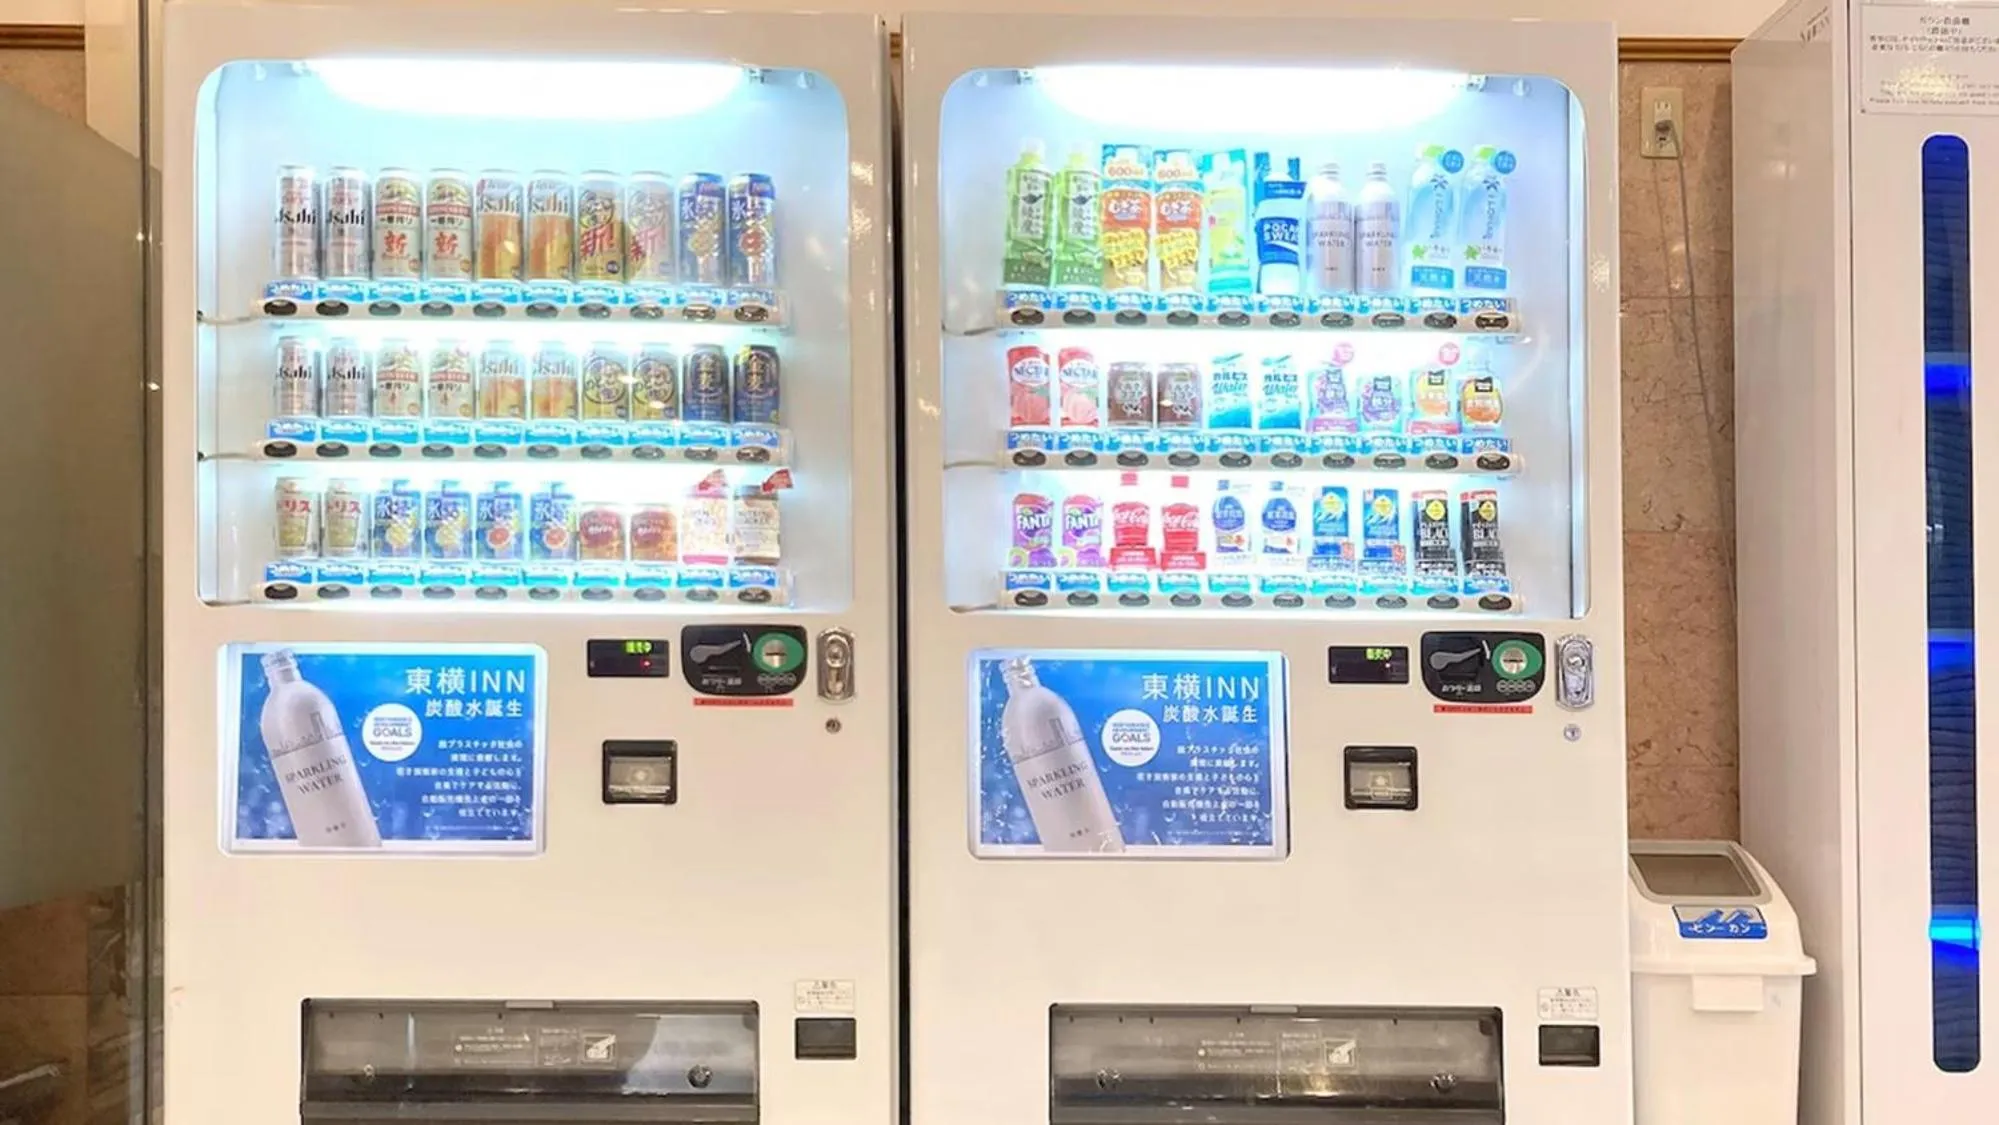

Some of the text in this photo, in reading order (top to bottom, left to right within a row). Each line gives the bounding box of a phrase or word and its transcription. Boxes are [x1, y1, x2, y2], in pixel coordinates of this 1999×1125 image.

[384, 231, 408, 254] 新
[435, 231, 459, 254] 新
[404, 666, 526, 695] 東横INN
[1142, 673, 1260, 700] 東横INN
[425, 698, 523, 718] 炭酸水誕生
[1162, 705, 1258, 724] 炭酸水誕生
[373, 727, 413, 738] GOALS
[1112, 733, 1151, 743] GOALS
[284, 754, 348, 784] SPARKLING
[1026, 761, 1089, 790] SPARKLING
[297, 773, 343, 795] WATER
[1040, 779, 1085, 800] WATER
